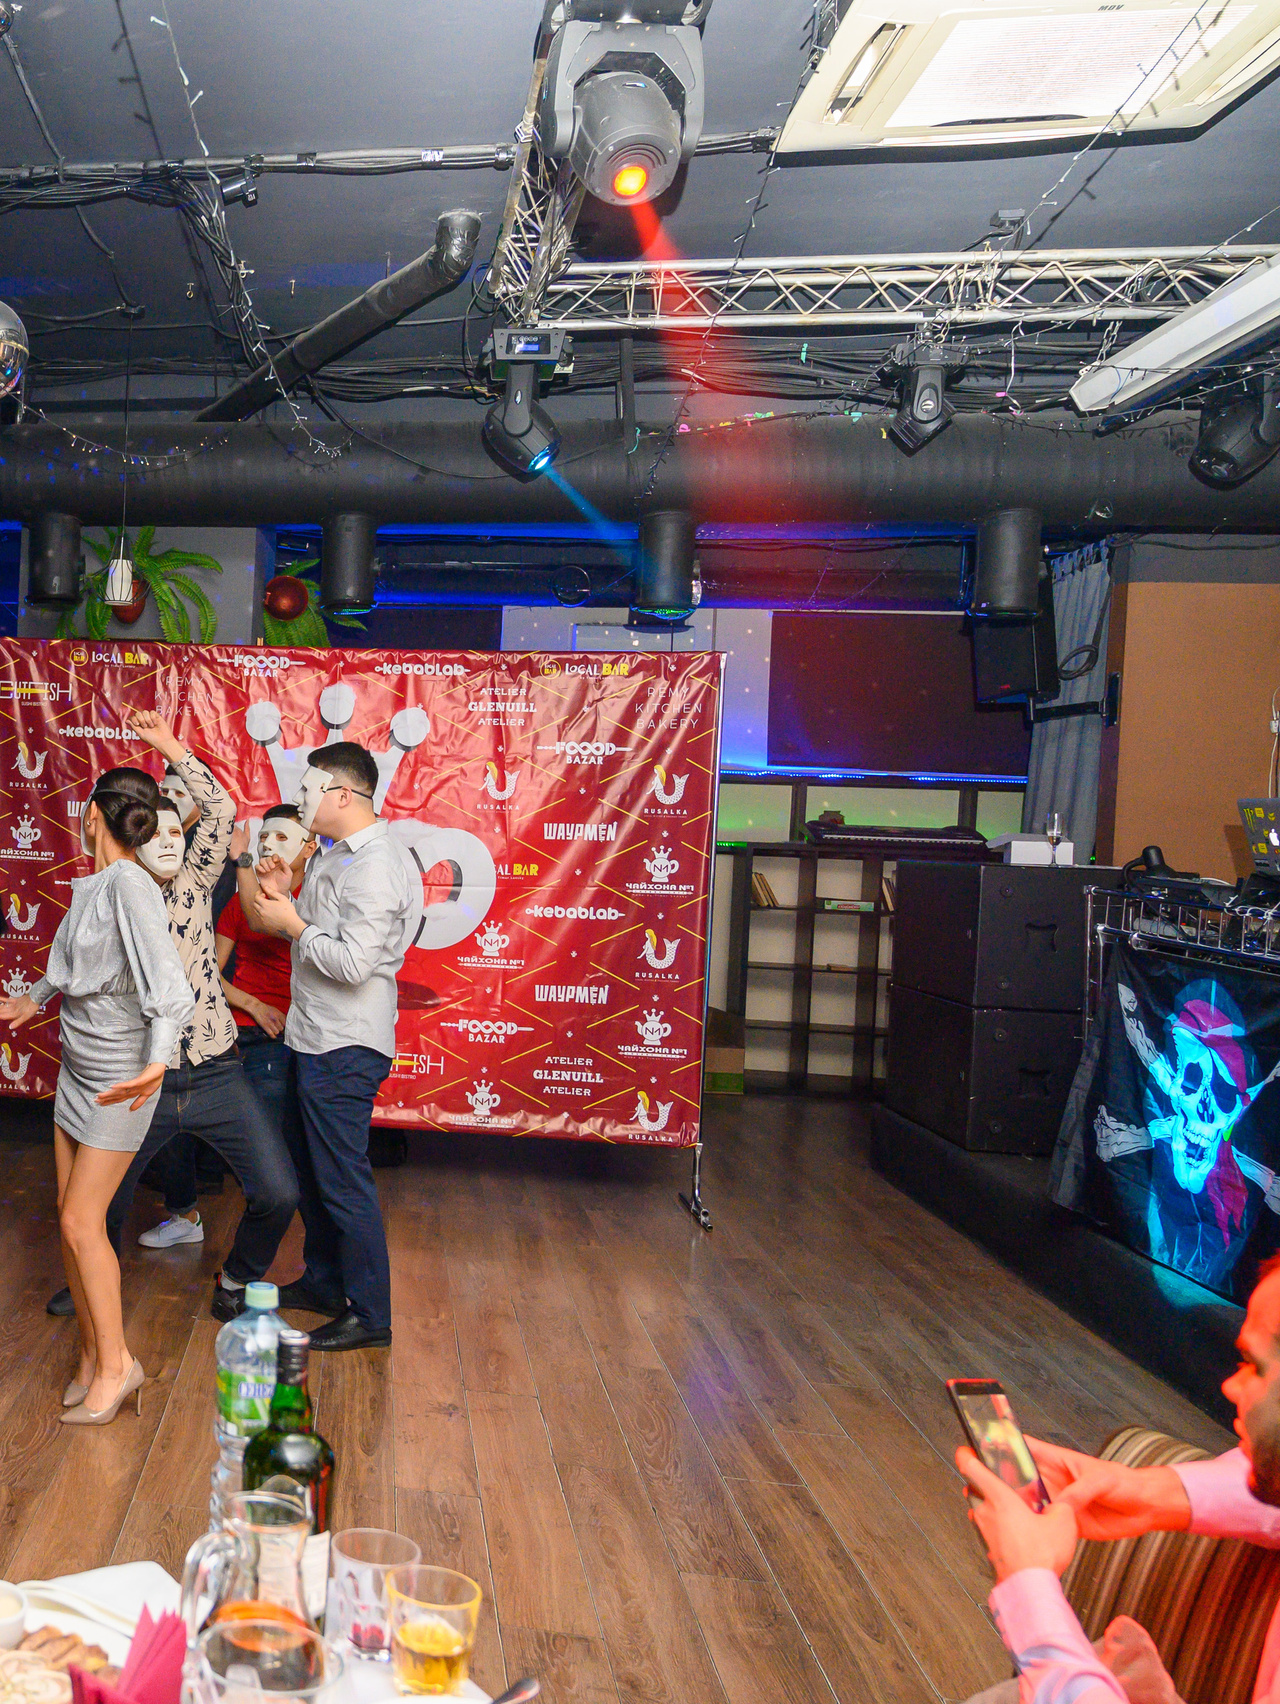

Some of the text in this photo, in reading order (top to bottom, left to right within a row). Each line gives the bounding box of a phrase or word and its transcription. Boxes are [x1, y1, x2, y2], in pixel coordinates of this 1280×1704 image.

[124, 652, 149, 665] BAR
[243, 668, 278, 678] BAZAR
[602, 663, 629, 676] BAR
[165, 675, 204, 687] REMY
[154, 690, 214, 703] KITCHEN
[480, 687, 527, 696] ATELIER
[647, 687, 690, 698] REMY
[468, 702, 537, 713] GLENUILL
[635, 702, 702, 714] KITCHEN
[478, 718, 525, 726] ATELIER
[636, 718, 699, 729] BAKERY
[566, 756, 604, 765] BAZAR
[9, 781, 48, 789] RUSALKA
[477, 803, 520, 811] RUSALKA
[513, 863, 539, 876] BAR
[625, 881, 677, 890] ЧАЙХОНА
[457, 955, 507, 965] ЧАЙХОНА
[635, 972, 680, 980] RUSALKA
[468, 1033, 506, 1044] BAZAR
[617, 1044, 669, 1053] ЧАЙХОНА
[545, 1056, 593, 1066] ATELIER
[532, 1070, 604, 1084] GLENUILL
[543, 1085, 591, 1096] ATELIER
[448, 1114, 498, 1123] ЧАЙХОНА
[628, 1133, 673, 1143] RUSALKA
